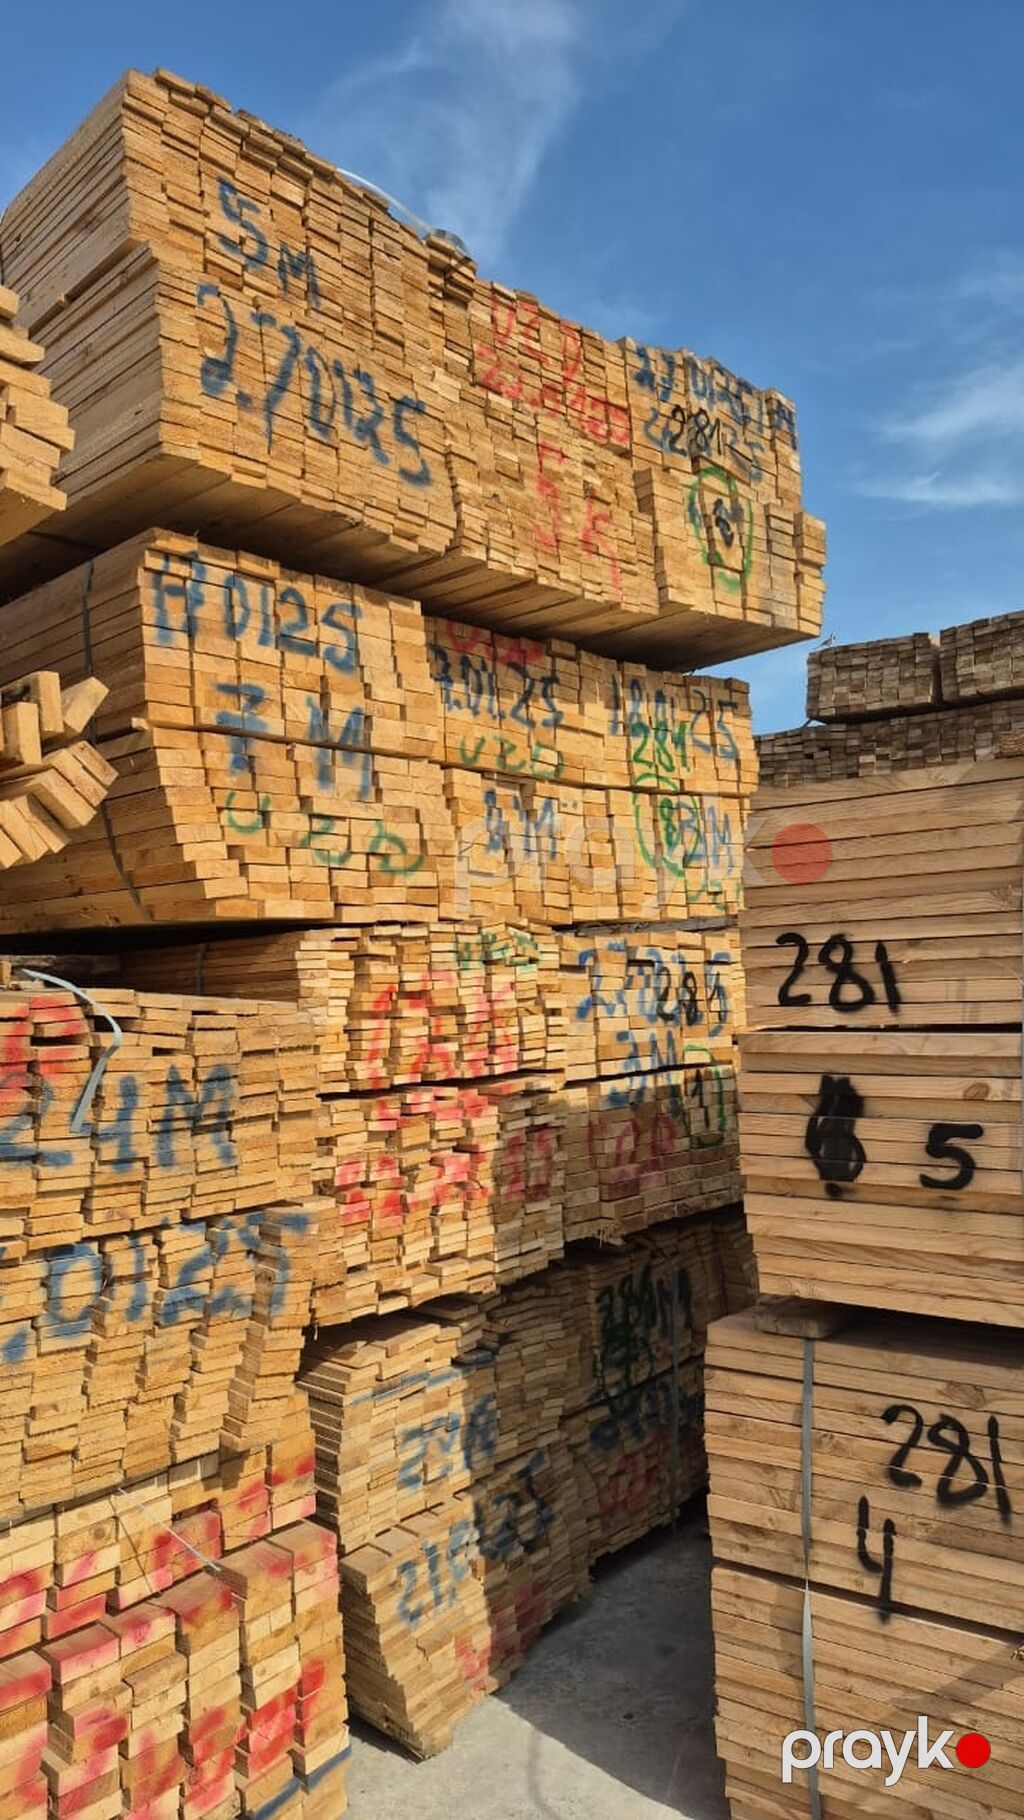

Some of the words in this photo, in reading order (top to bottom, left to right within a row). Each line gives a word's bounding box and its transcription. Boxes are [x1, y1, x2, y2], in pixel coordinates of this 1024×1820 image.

[776, 932, 899, 1015] 281
[918, 1122, 985, 1191] 5
[880, 1403, 1013, 1529] 281
[856, 1494, 898, 1626] 4
